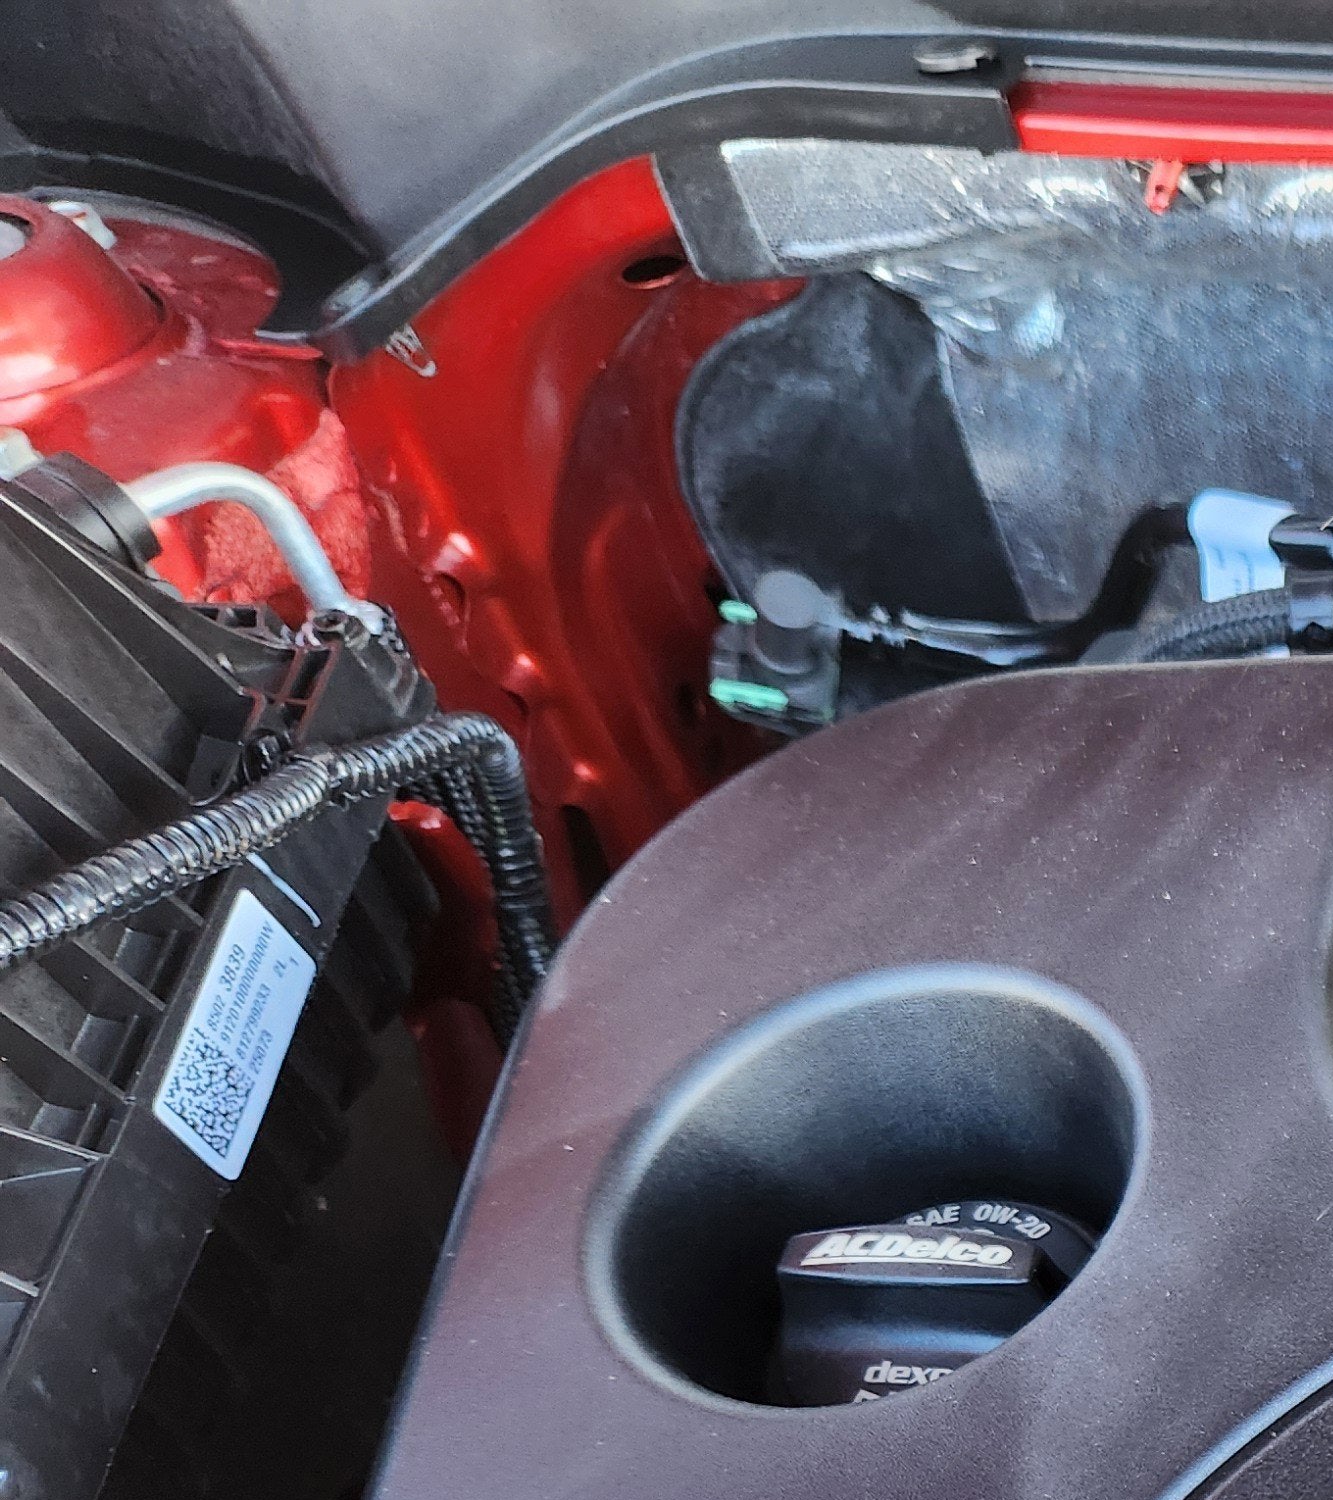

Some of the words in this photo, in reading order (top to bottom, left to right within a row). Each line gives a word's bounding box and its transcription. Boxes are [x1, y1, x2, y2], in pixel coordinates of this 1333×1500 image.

[207, 995, 227, 1032] 8502
[220, 944, 245, 991] 3839
[906, 1205, 961, 1226] SAE
[972, 1203, 1051, 1239] 0W-20
[803, 1232, 1013, 1266] ACDelco
